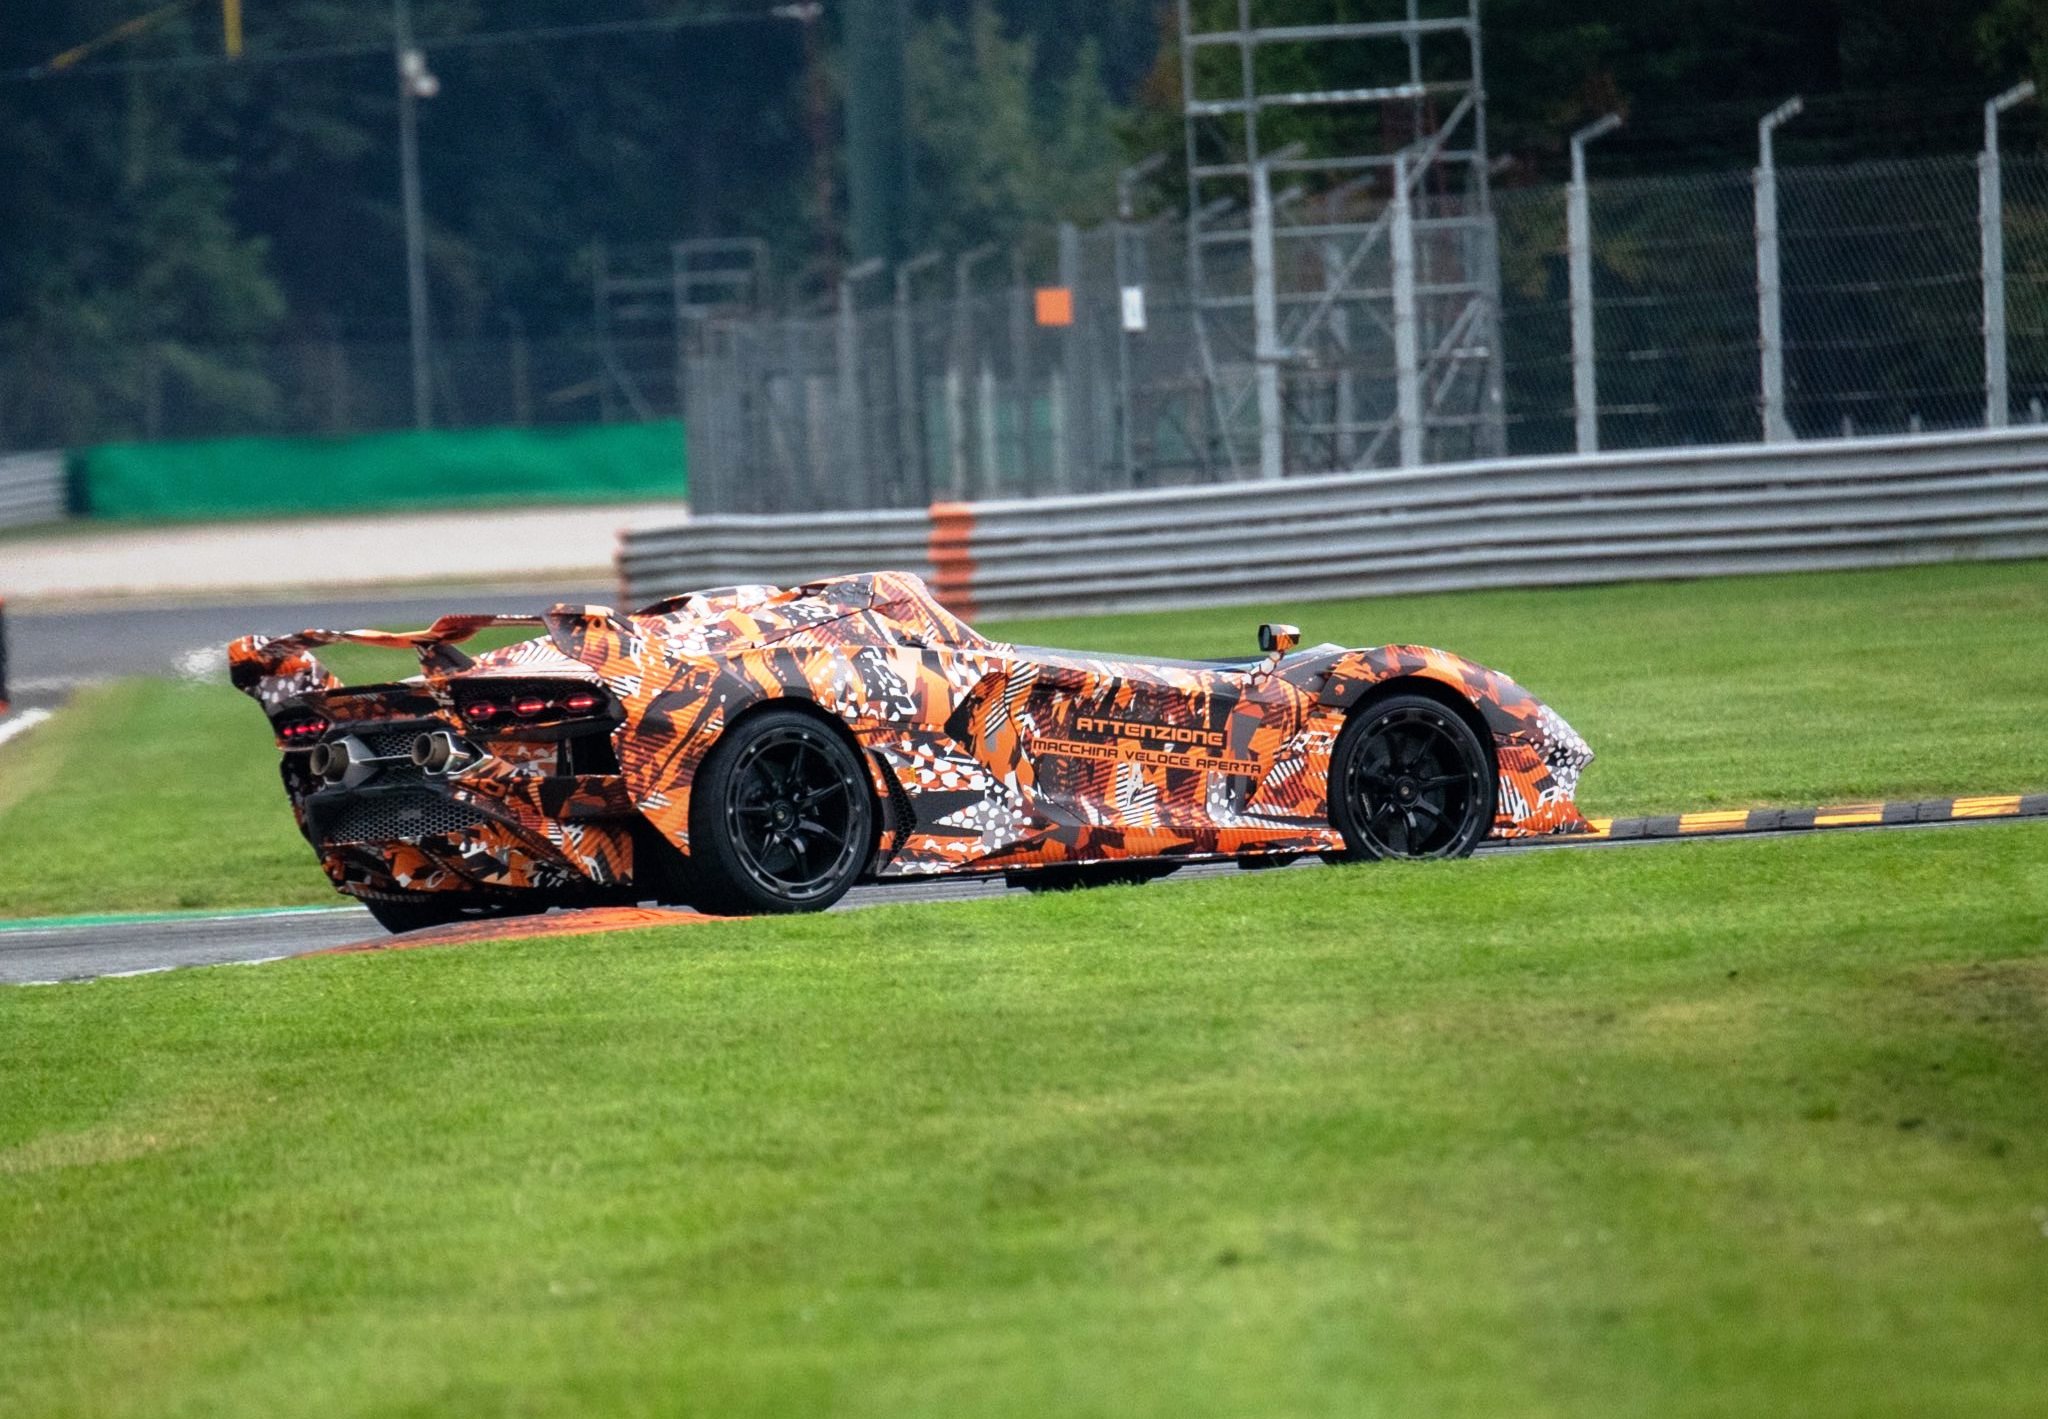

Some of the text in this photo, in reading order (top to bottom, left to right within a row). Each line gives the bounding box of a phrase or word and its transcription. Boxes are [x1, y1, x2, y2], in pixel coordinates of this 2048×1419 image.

[1076, 717, 1224, 746] ATTENZIONE
[1033, 739, 1262, 775] MACCHINA VELOCE APERTA
